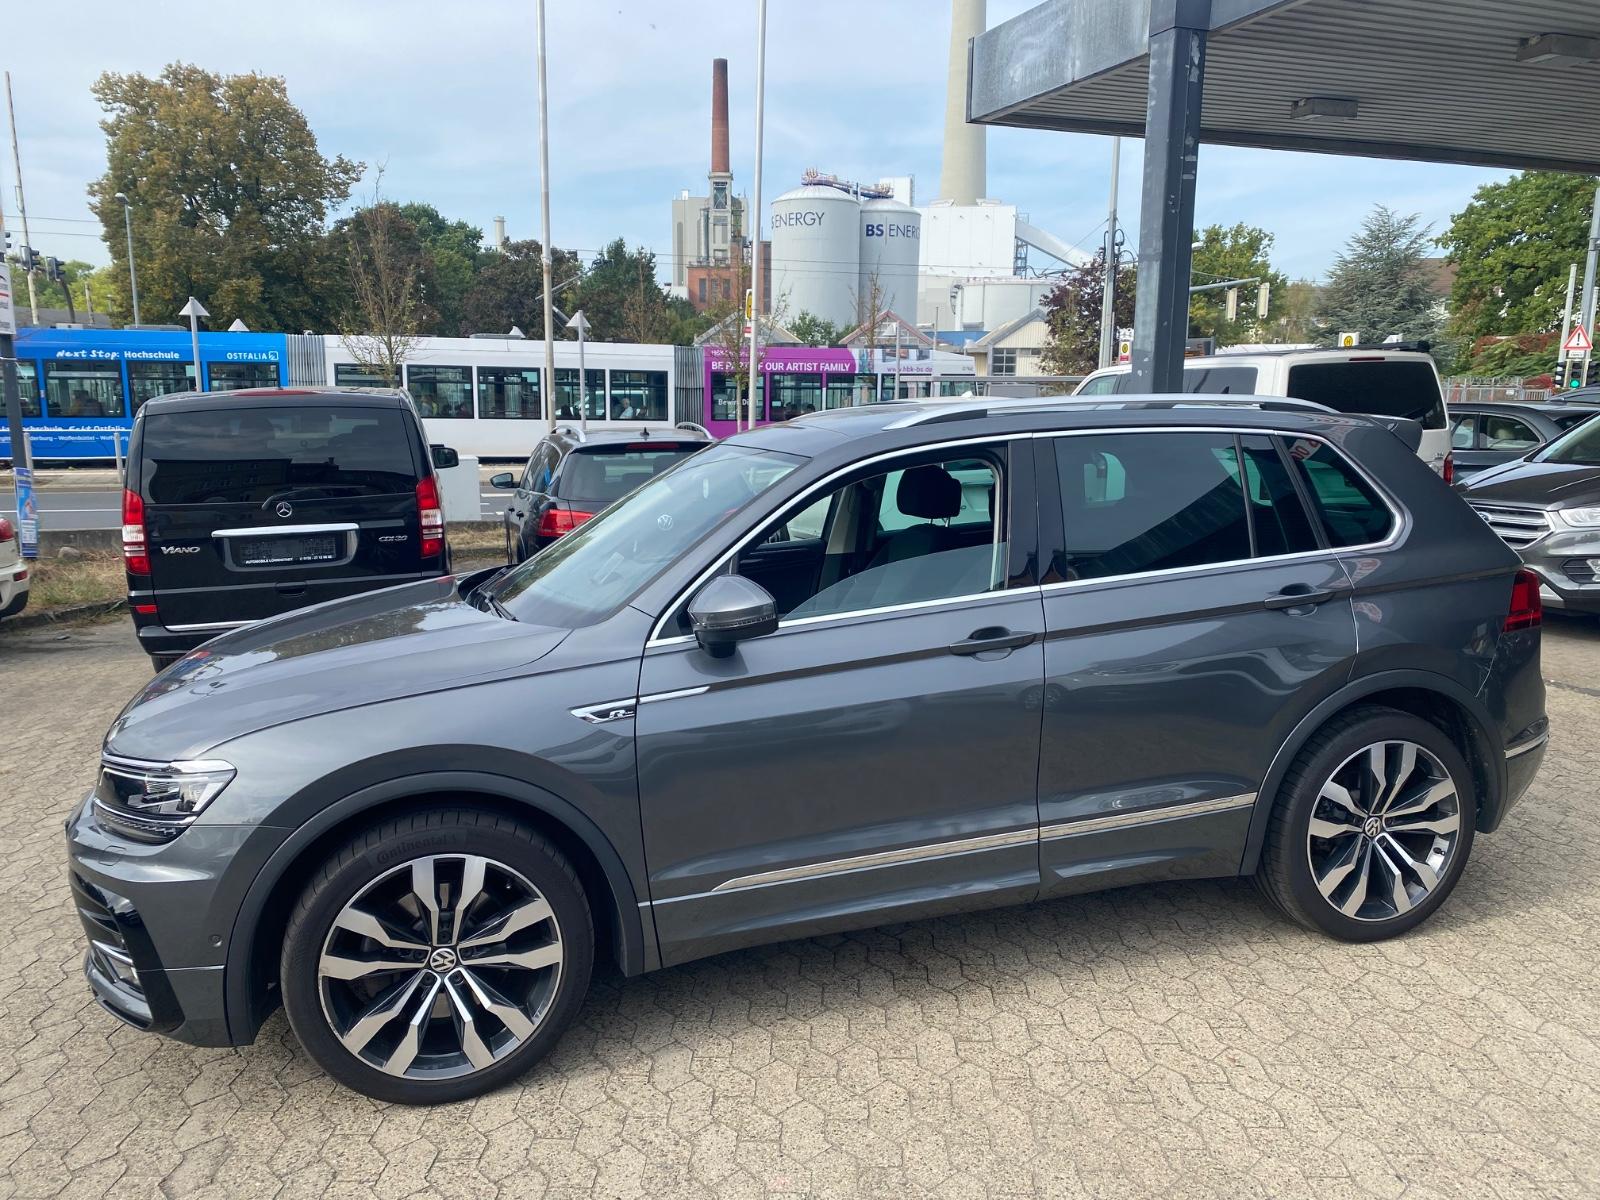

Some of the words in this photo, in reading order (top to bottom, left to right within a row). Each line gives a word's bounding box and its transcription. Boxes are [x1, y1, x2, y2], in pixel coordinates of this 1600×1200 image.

[775, 211, 825, 228] ENERGY
[865, 224, 884, 237] BS
[56, 350, 87, 358] Next
[89, 350, 120, 360] Stop:
[124, 351, 180, 359] Hochschule
[226, 352, 267, 360] OSTFALIA
[711, 361, 725, 371] BE
[765, 362, 784, 371] OUR
[786, 363, 818, 372] ARTIST
[820, 363, 850, 372] FAMILY
[718, 398, 737, 406] Bewir
[160, 546, 201, 555] VIANO
[377, 833, 447, 864] Continental
